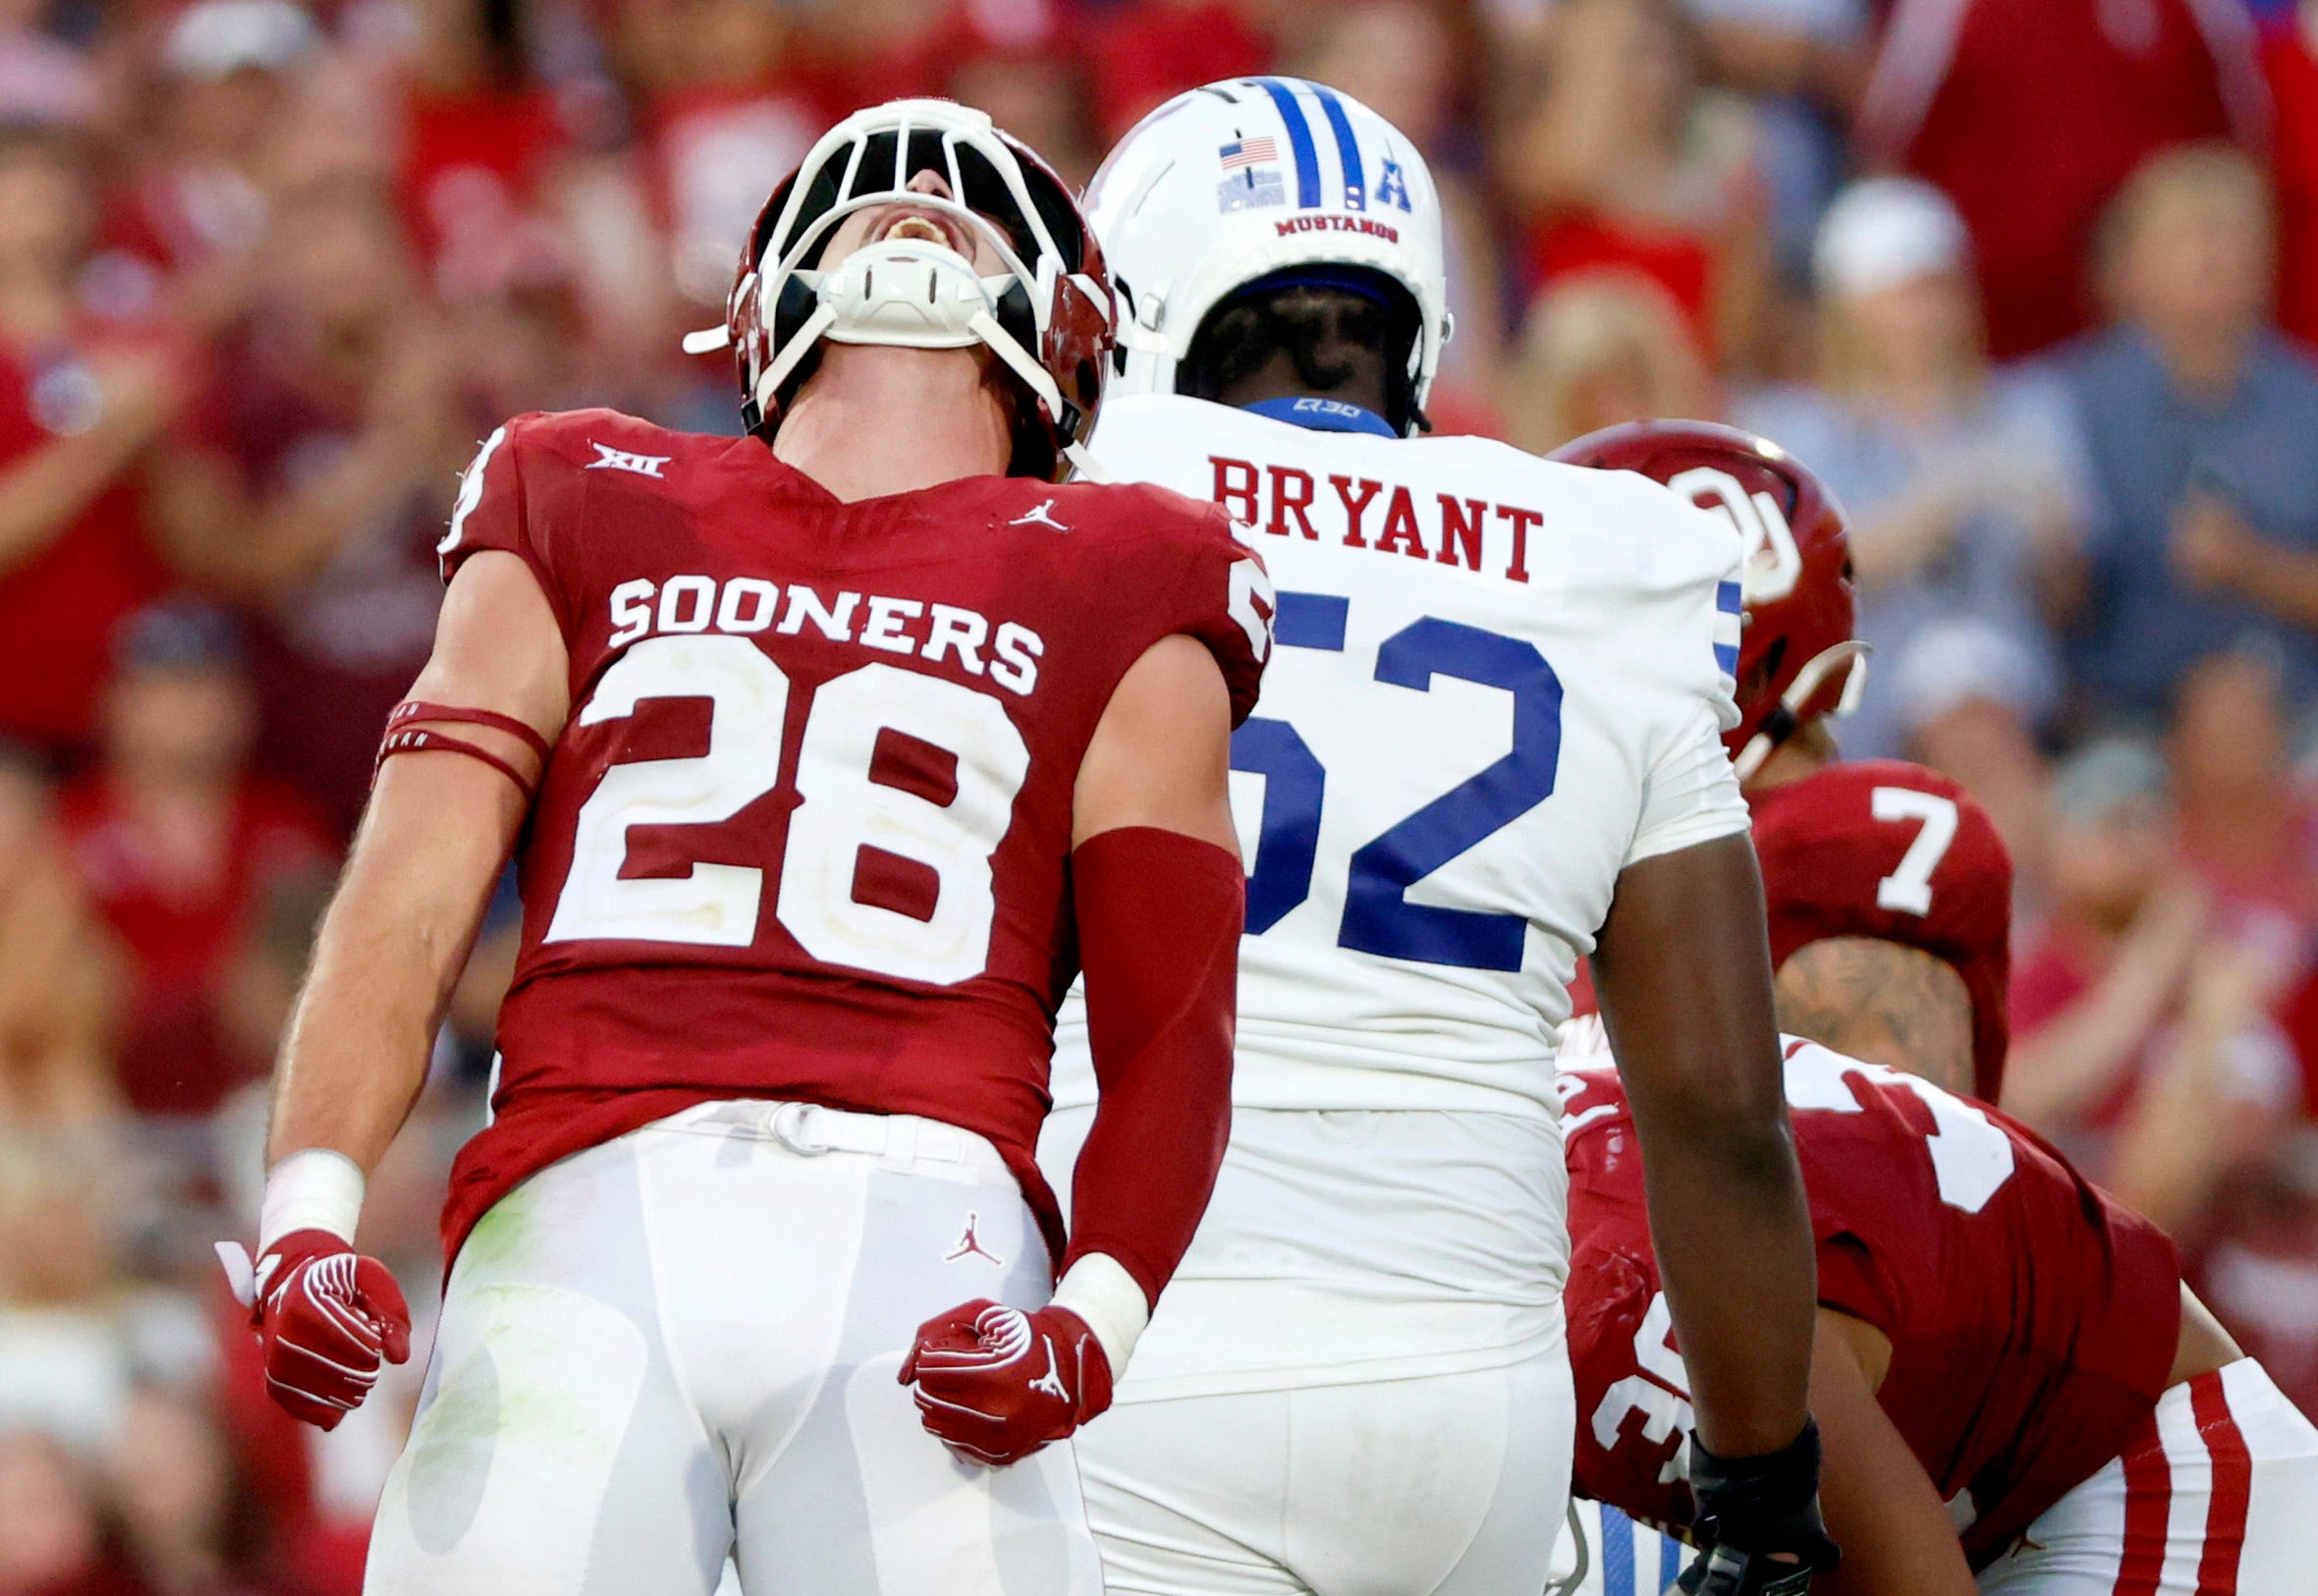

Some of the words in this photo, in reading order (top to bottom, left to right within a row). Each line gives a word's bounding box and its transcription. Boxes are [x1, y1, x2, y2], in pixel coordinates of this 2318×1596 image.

[584, 441, 672, 478] XII
[1208, 455, 1544, 583] BRYANT
[608, 575, 1045, 696] SOONERS
[541, 633, 1031, 986] 28
[1872, 786, 1958, 916] 7
